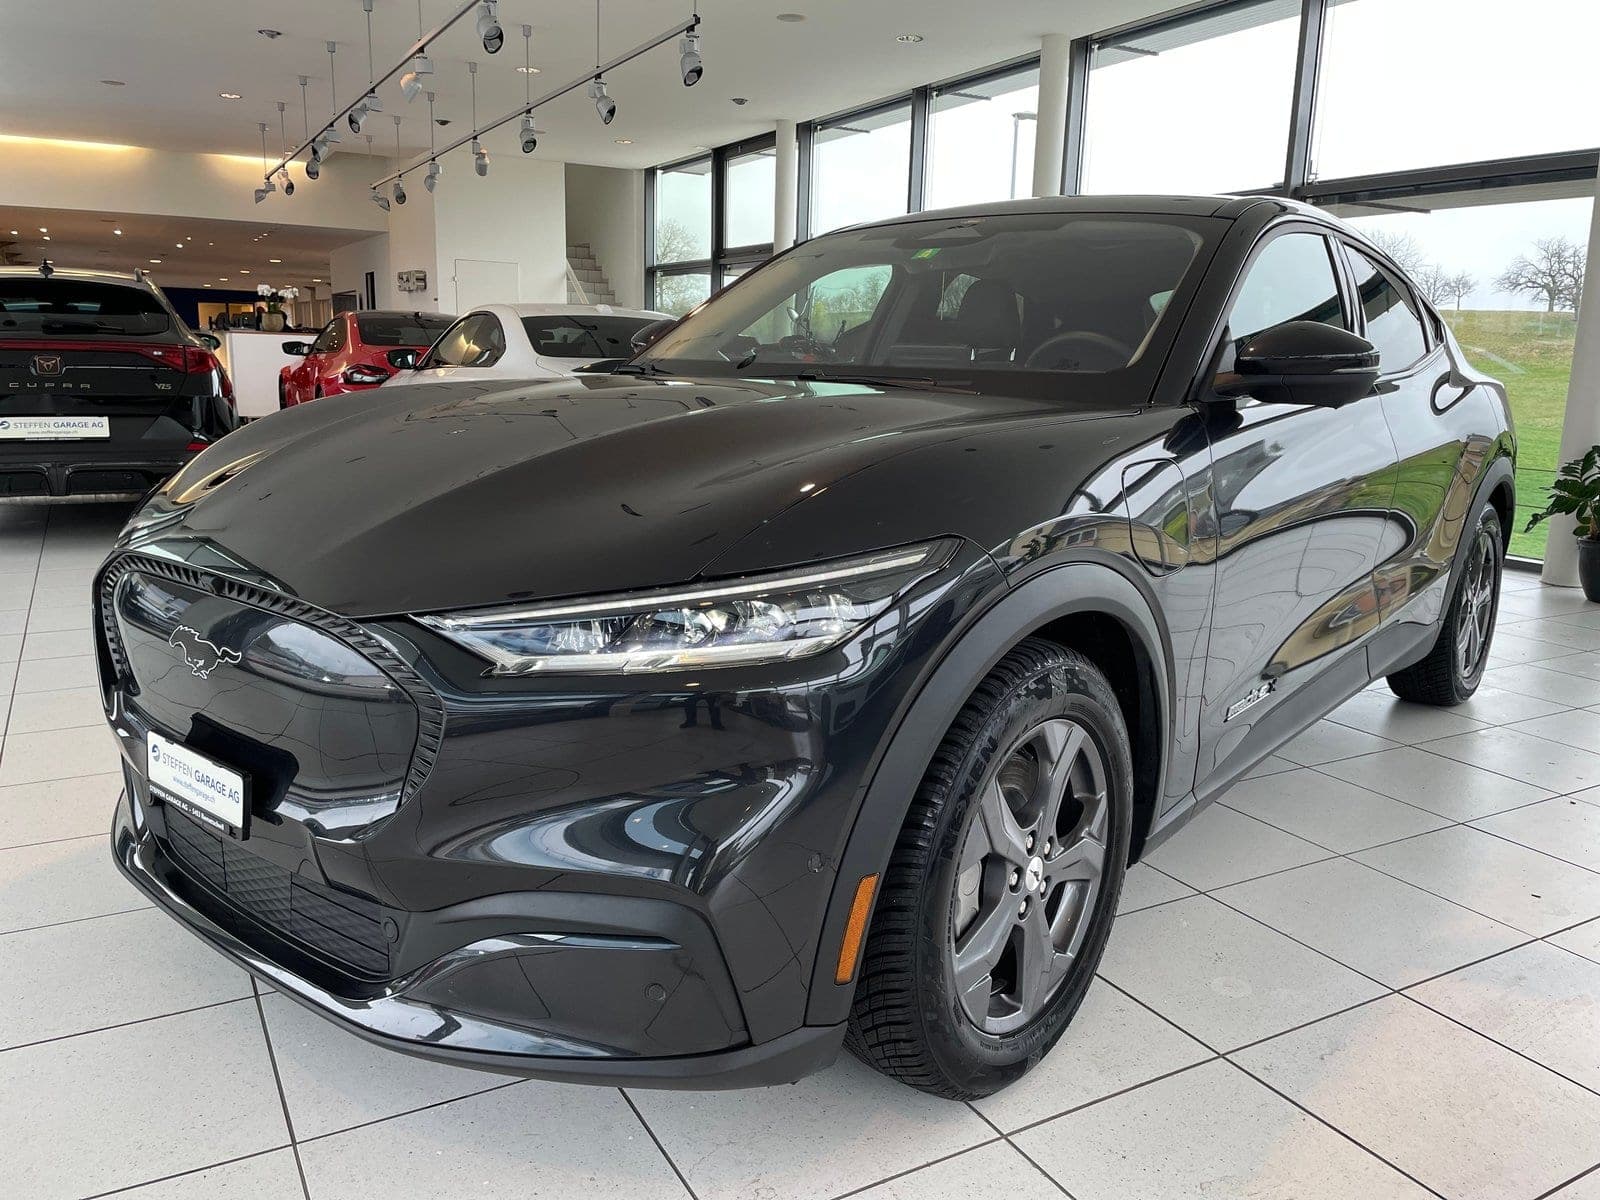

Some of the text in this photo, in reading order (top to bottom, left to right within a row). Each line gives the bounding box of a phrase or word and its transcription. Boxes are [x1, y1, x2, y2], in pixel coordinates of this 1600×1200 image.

[13, 421, 51, 429] STEFFEN
[162, 752, 240, 804] STEFFEN GARAGE AG
